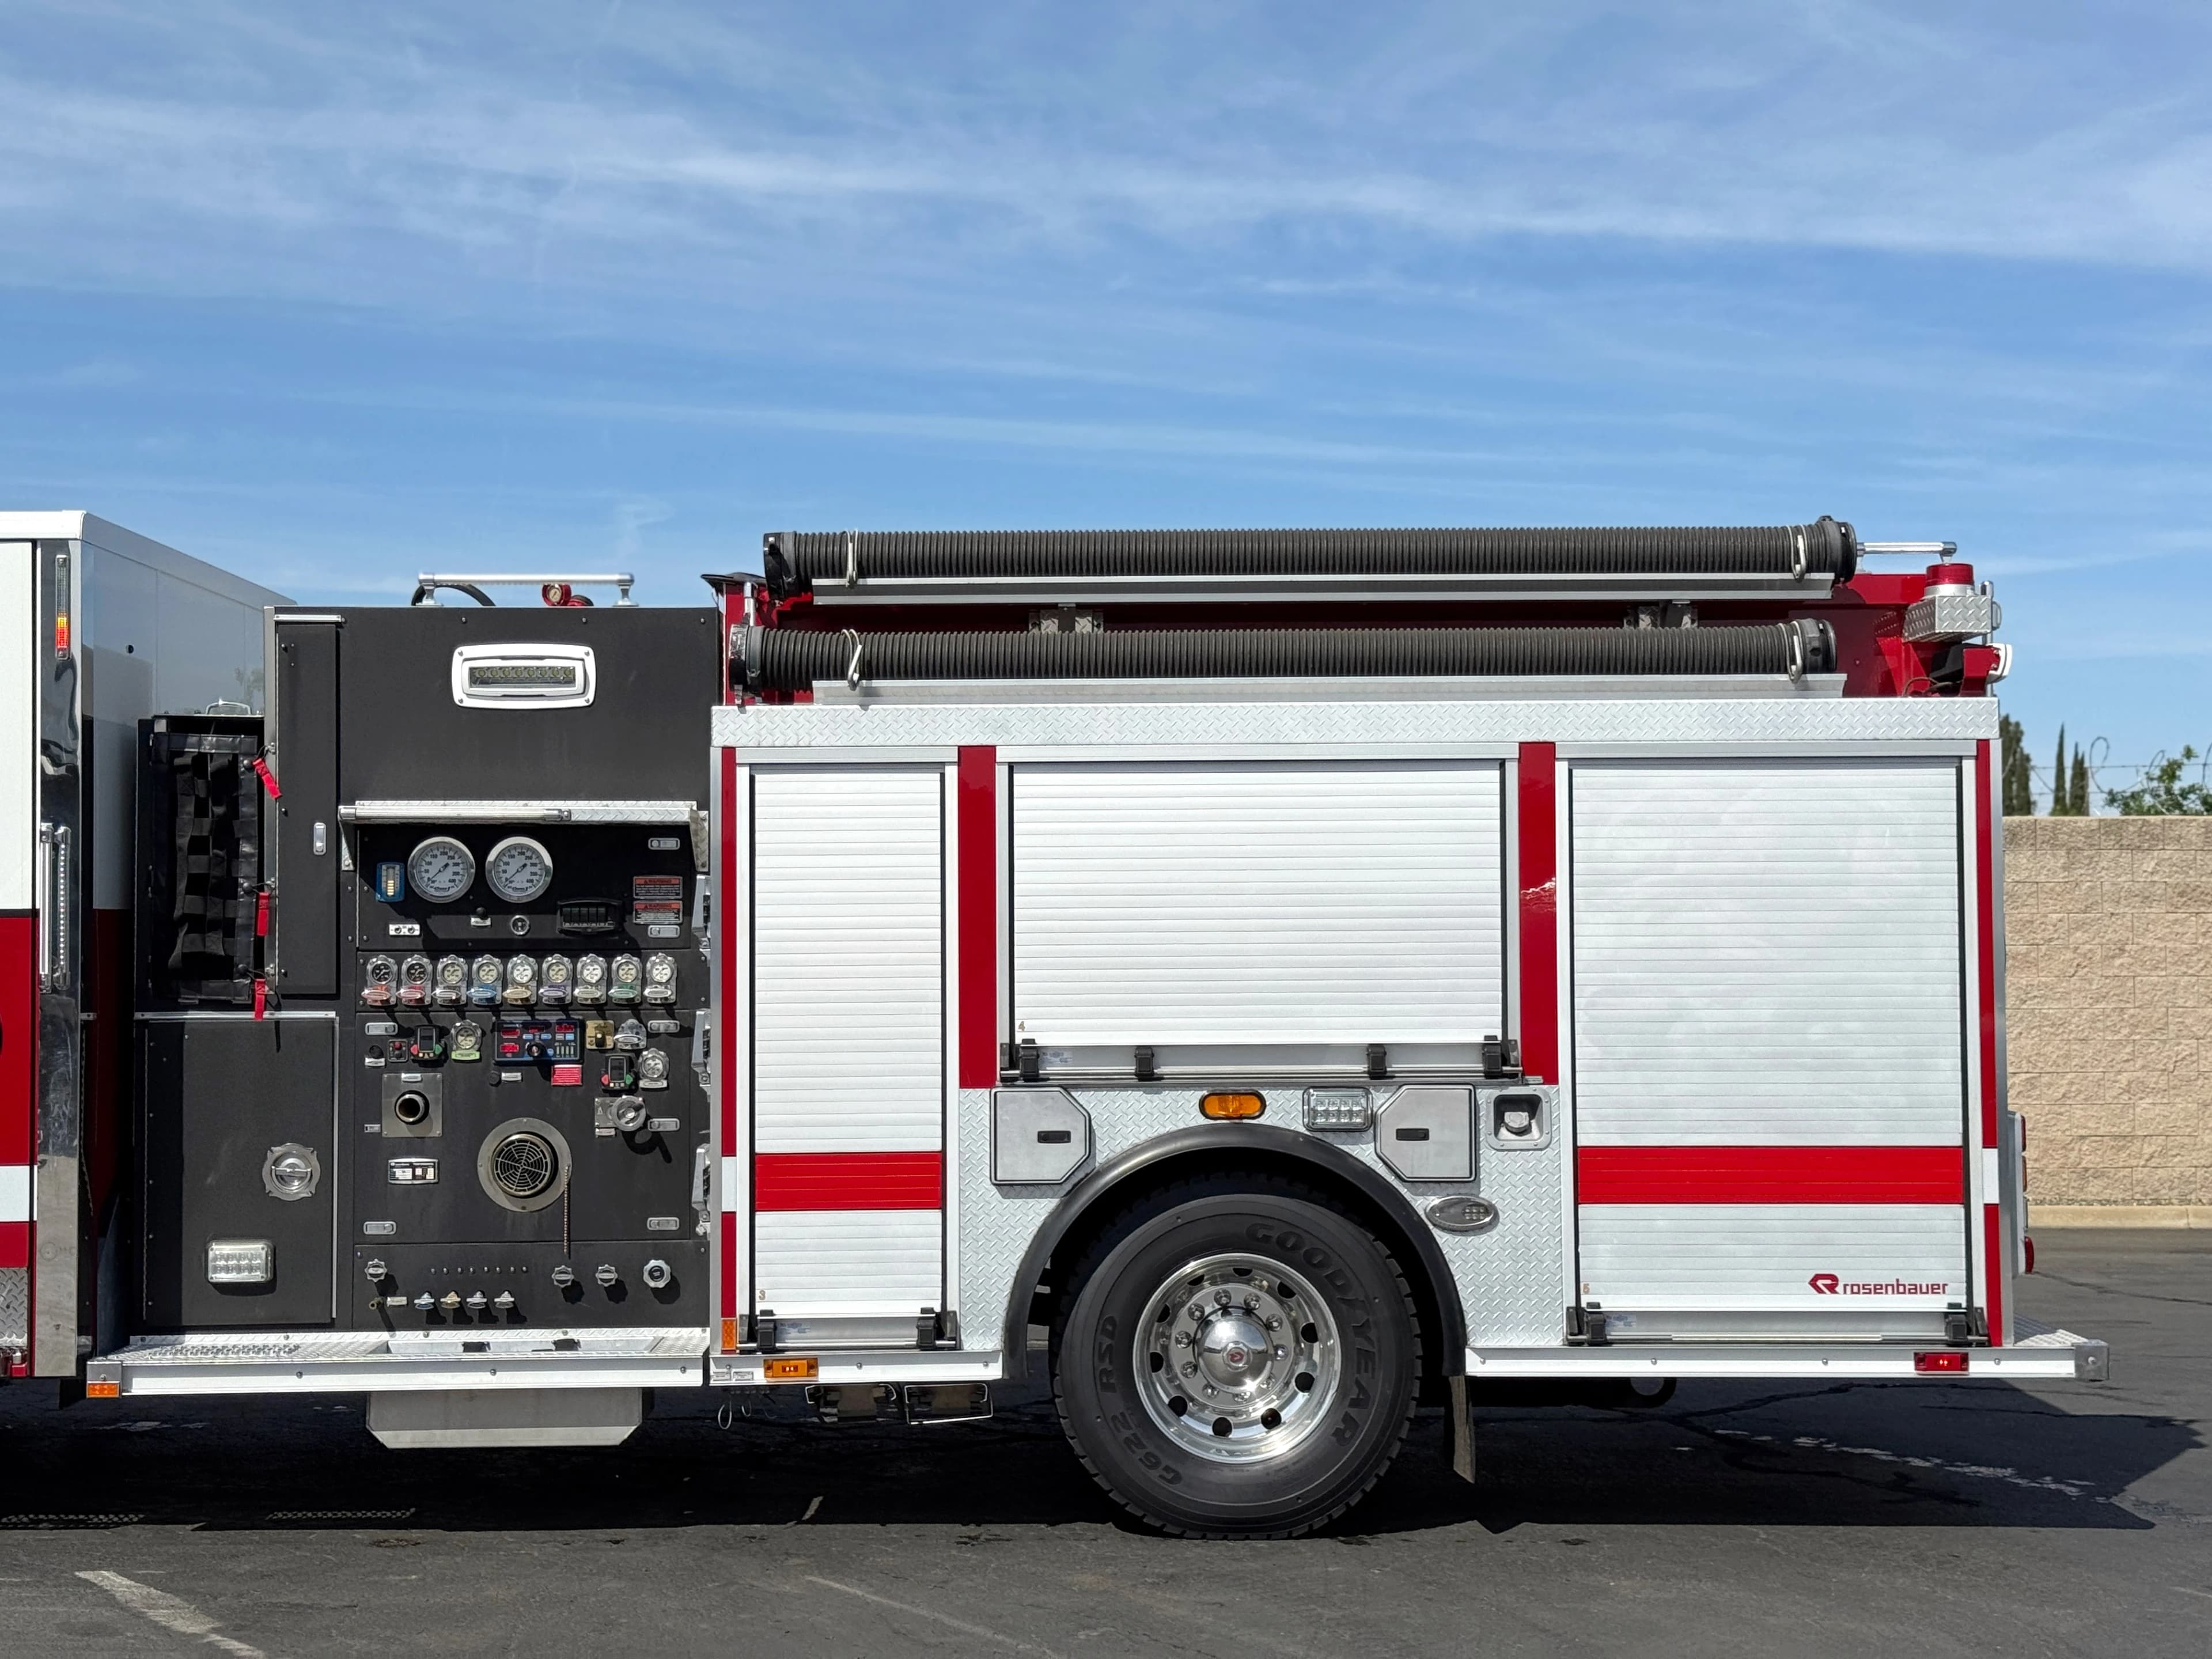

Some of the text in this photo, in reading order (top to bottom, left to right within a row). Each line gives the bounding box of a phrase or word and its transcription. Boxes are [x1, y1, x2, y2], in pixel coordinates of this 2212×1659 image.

[1018, 1020, 1025, 1032] 4
[1843, 1278, 1948, 1295] rosenbauer
[759, 1290, 766, 1301] 3
[1245, 1222, 1376, 1447] GOODYEAR
[1098, 1315, 1183, 1485] G622 RSD
